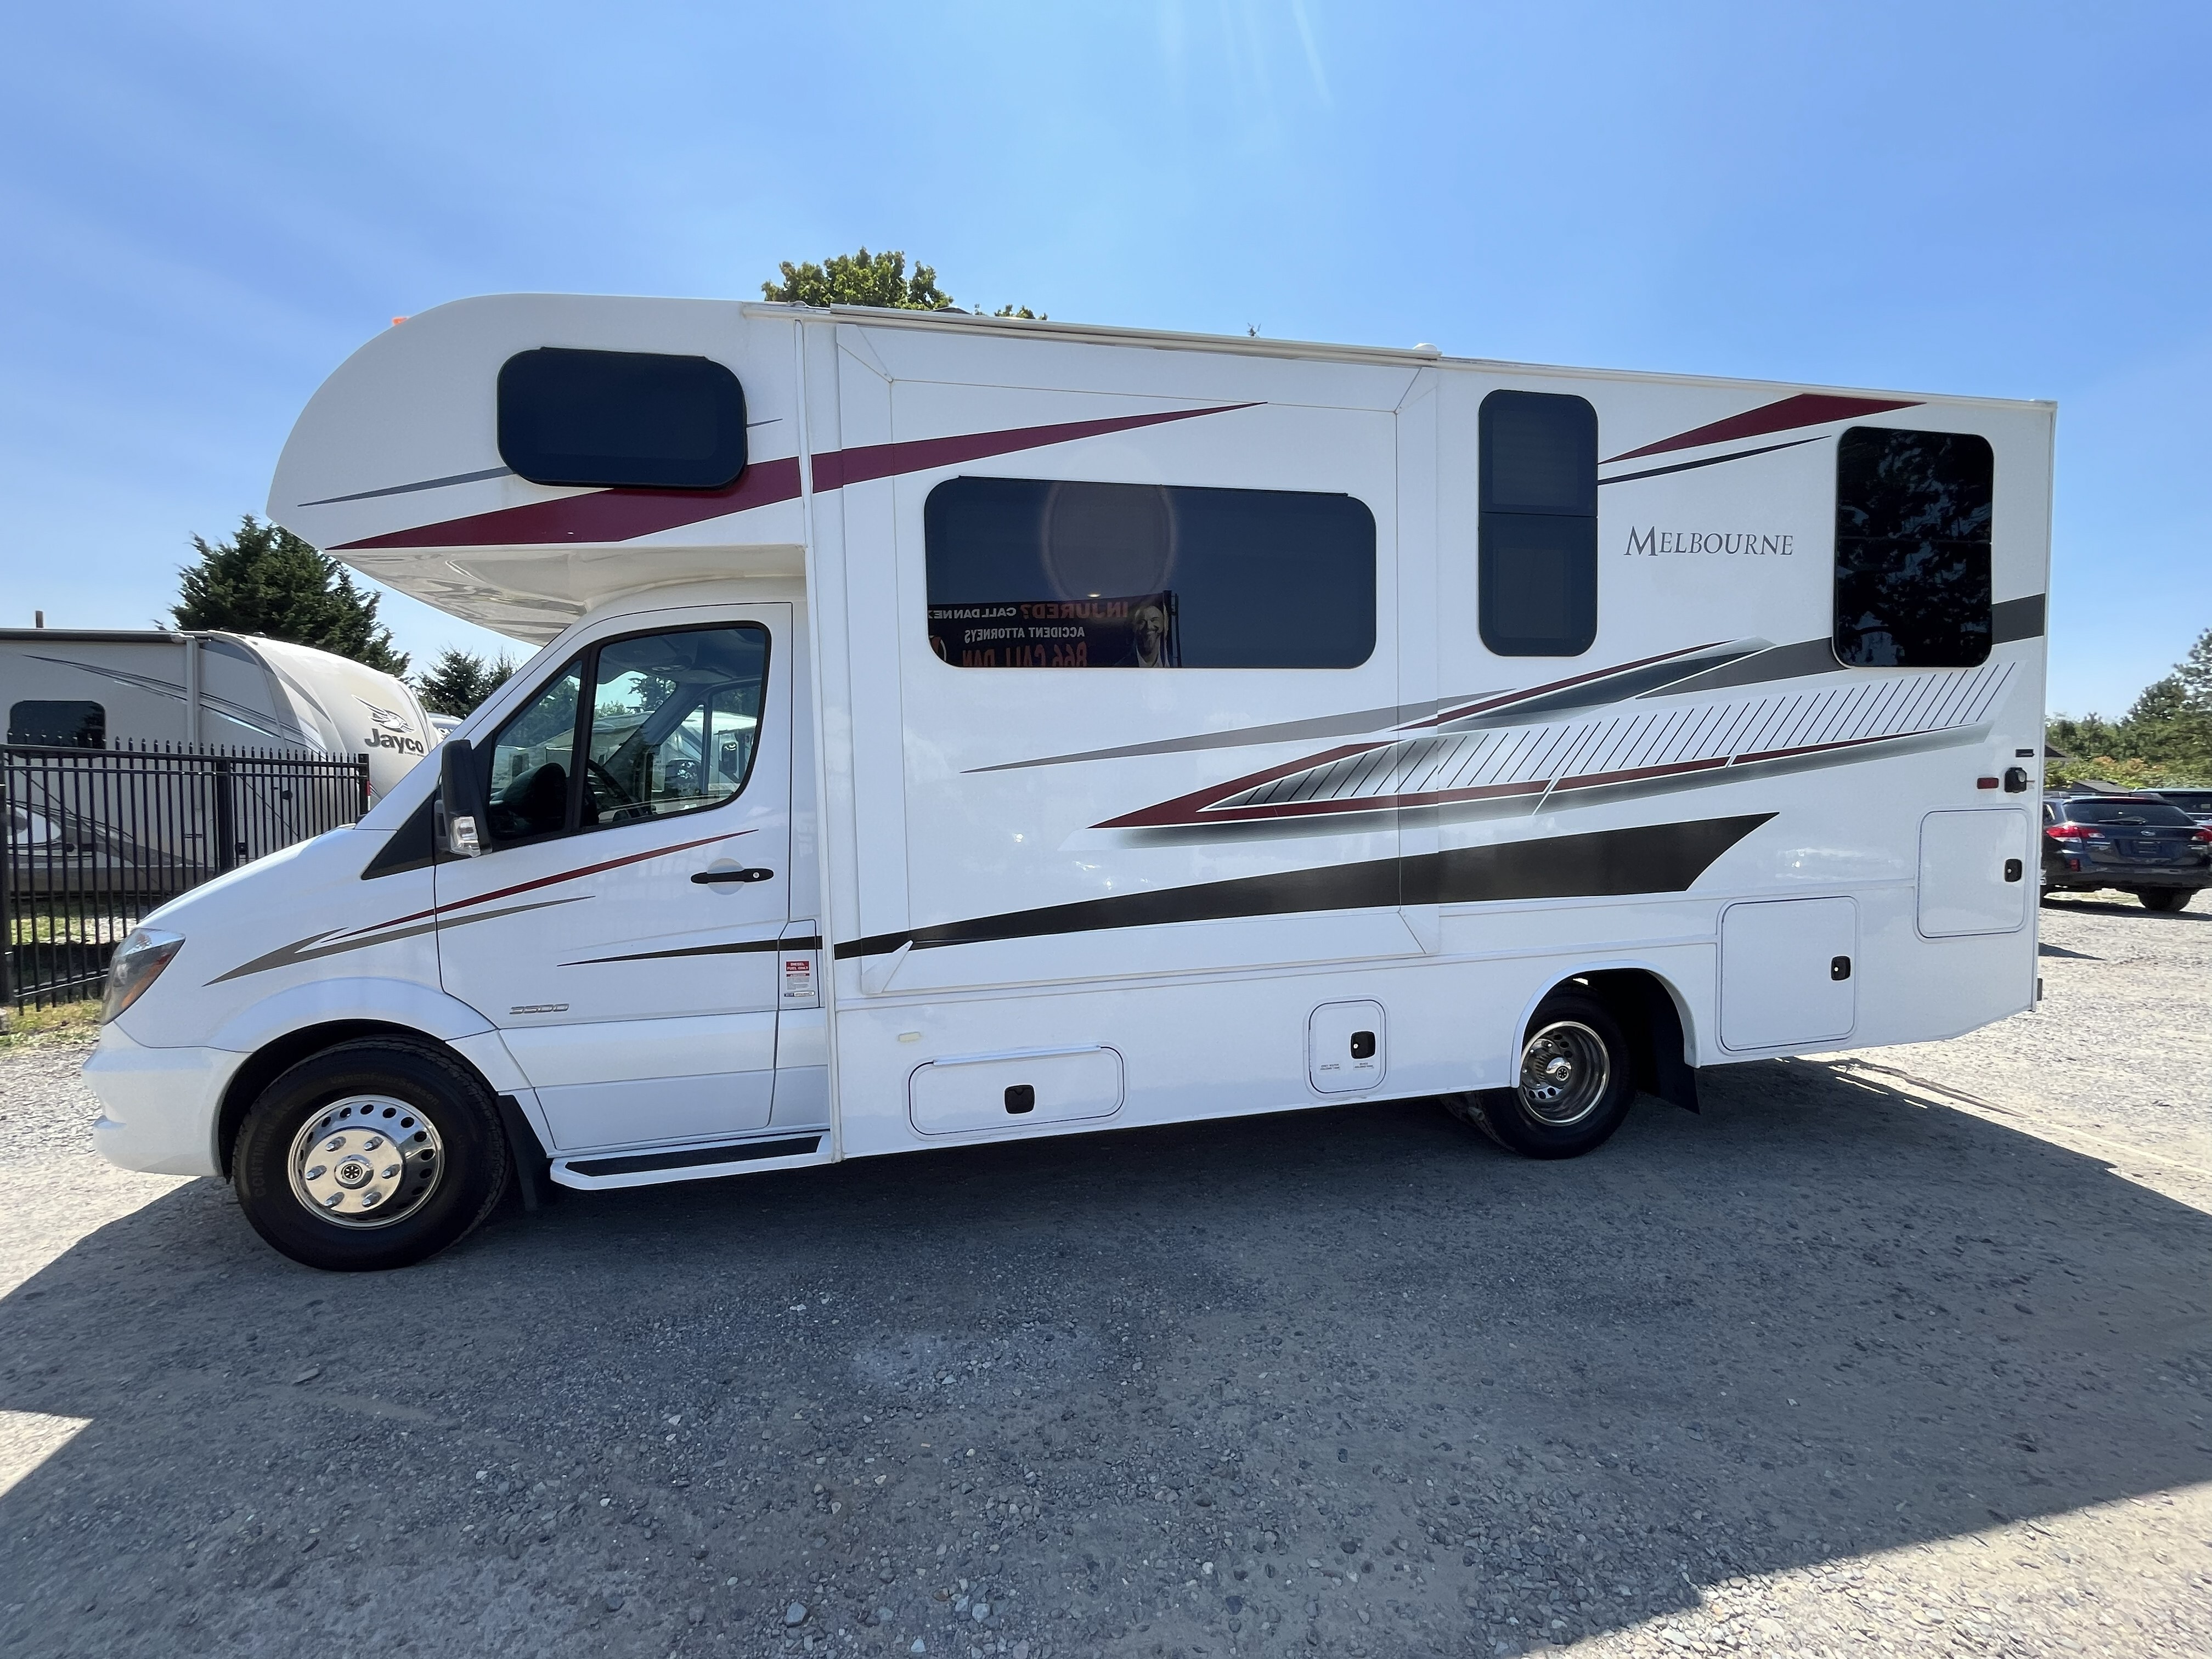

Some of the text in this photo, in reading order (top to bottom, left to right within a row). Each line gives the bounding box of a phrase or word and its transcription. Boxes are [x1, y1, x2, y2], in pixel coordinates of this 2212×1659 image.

[1623, 525, 1793, 556] MELBOURNE
[364, 727, 424, 754] Jayco
[509, 1003, 569, 1015] 3500
[250, 1103, 296, 1199] CONTINENAL
